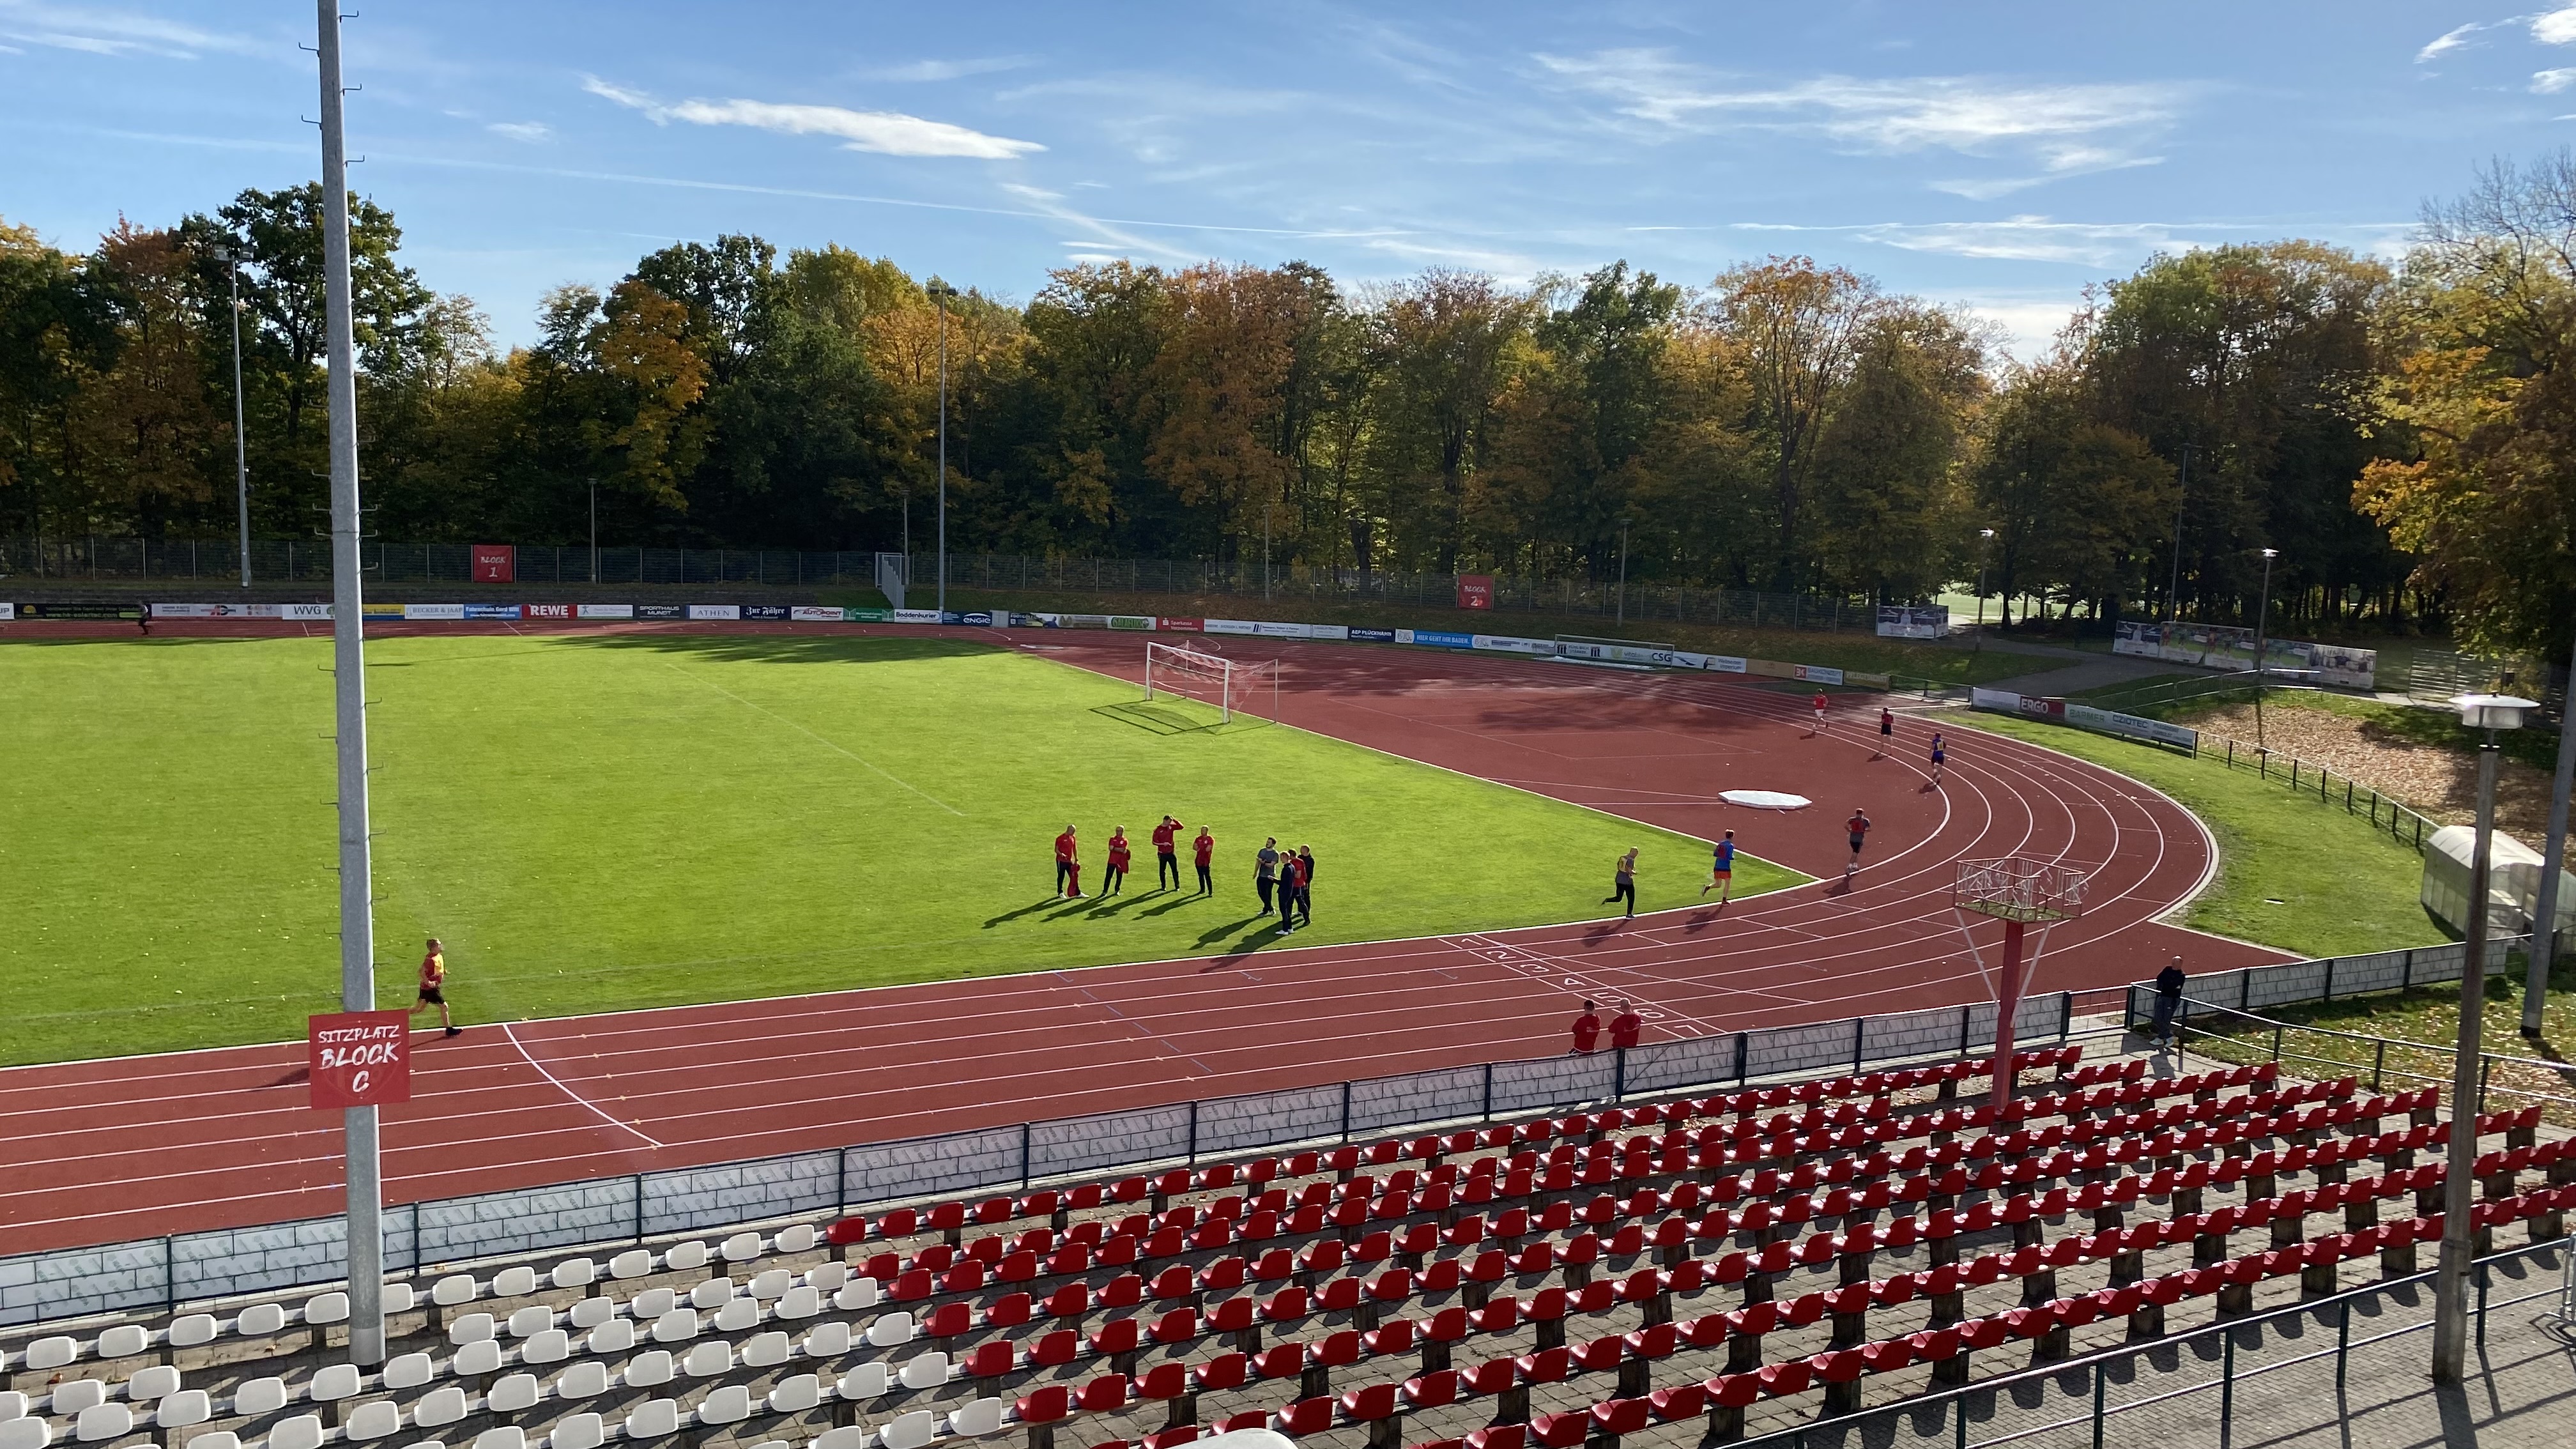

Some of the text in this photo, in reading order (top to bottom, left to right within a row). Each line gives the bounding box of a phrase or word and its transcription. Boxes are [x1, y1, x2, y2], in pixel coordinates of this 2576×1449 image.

[480, 556, 507, 564] BLOCK
[489, 566, 498, 578] 1
[1470, 595, 1478, 606] 2
[294, 606, 321, 615] WVG
[530, 605, 569, 616] REWE
[746, 606, 785, 615] Zur Fähre
[1652, 652, 1671, 662] CSG
[2021, 698, 2049, 714] ERGO
[2069, 709, 2106, 723] BARMER
[1486, 949, 1517, 960] 2
[1520, 962, 1550, 973] 3
[1564, 977, 1587, 986] 4
[1591, 992, 1628, 1004] 5
[1633, 1007, 1665, 1019] 6
[318, 1024, 401, 1043] SITZPLATZ
[1674, 1024, 1703, 1036] 7
[318, 1041, 402, 1070] BLOCK
[352, 1070, 370, 1093] C
